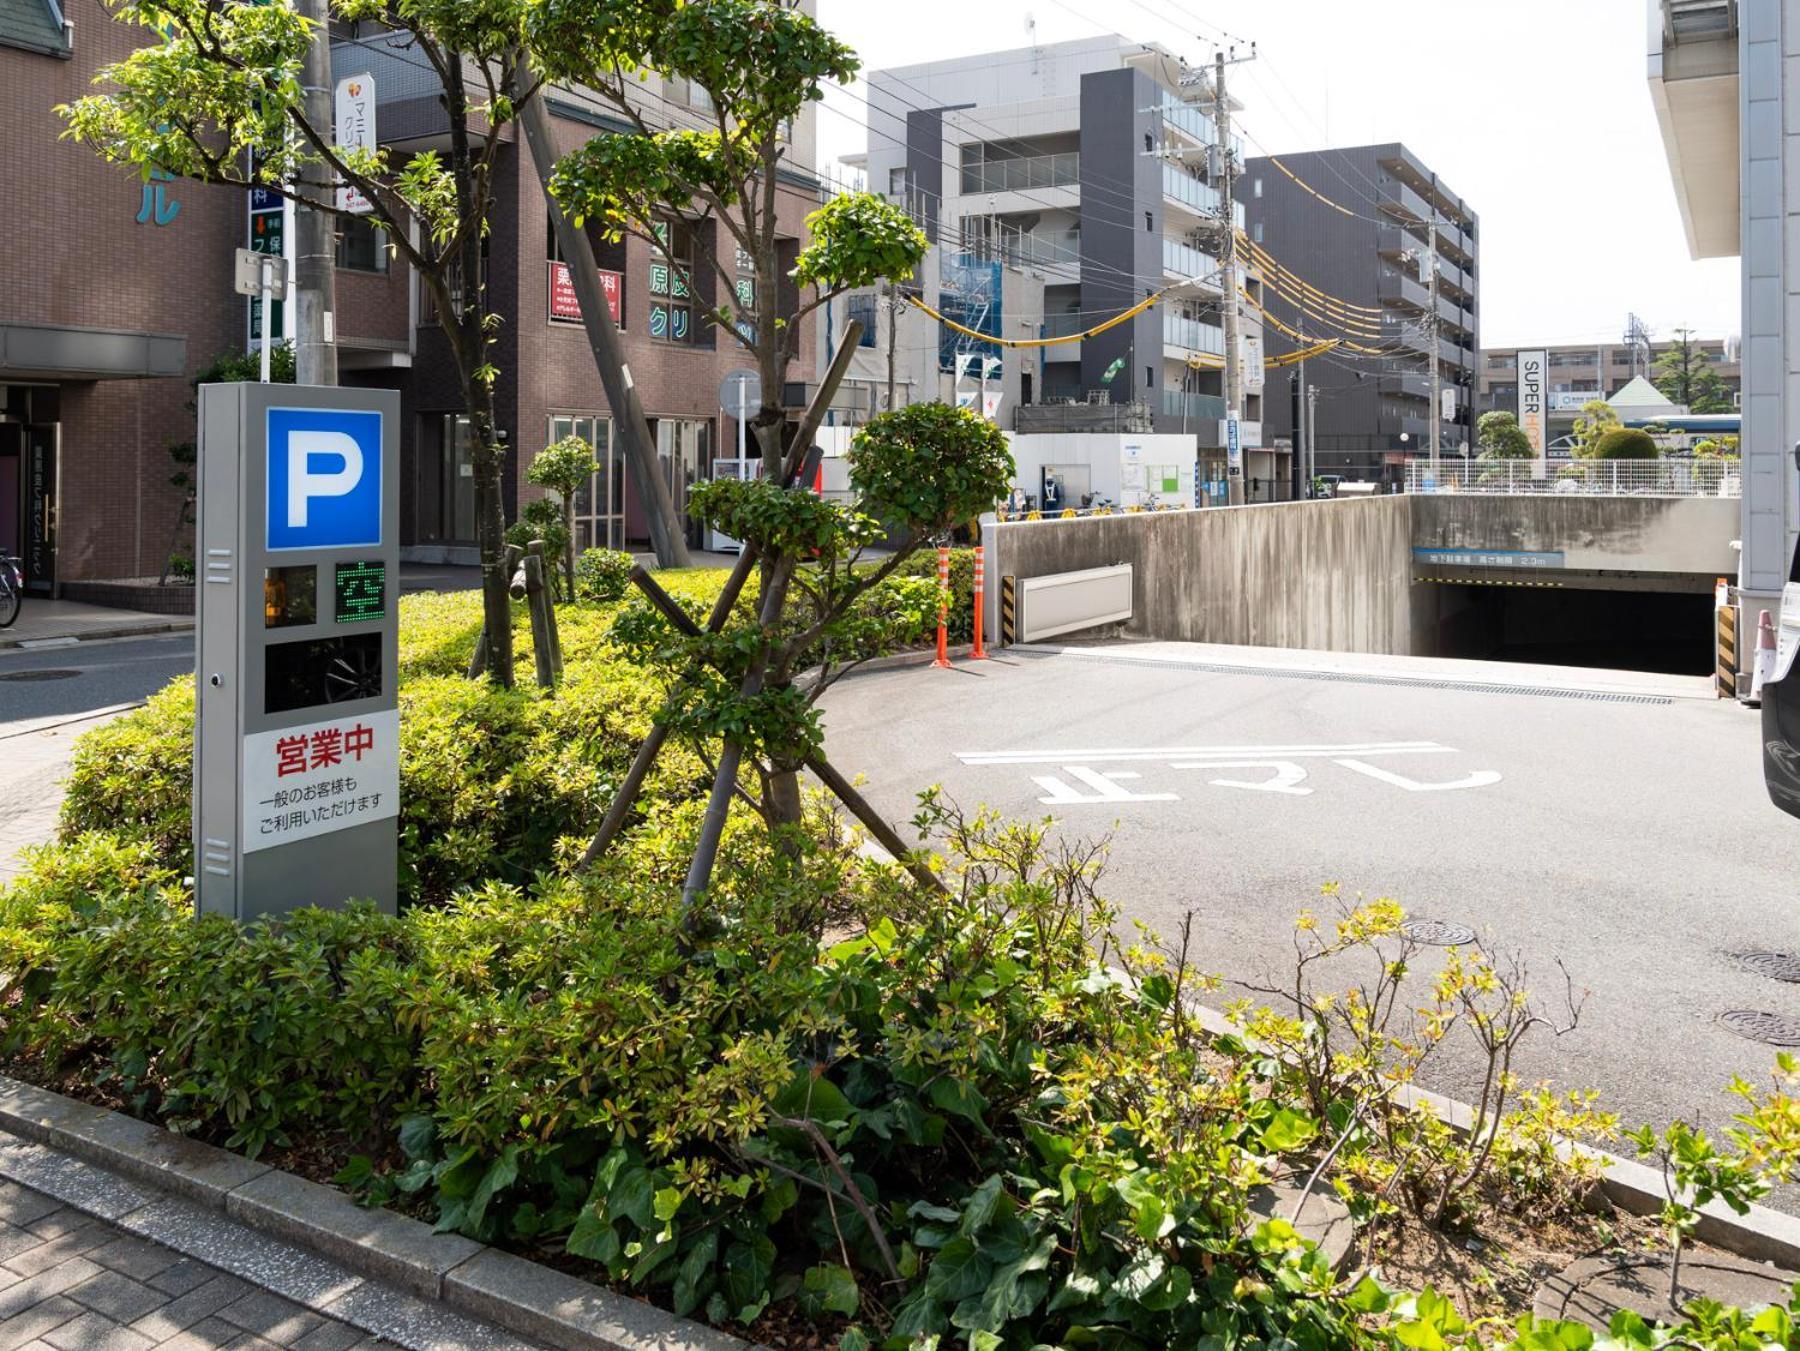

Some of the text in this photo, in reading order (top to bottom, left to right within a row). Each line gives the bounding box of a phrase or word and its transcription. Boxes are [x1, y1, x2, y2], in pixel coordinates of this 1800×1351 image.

[1524, 360, 1540, 414] SUPER
[287, 430, 364, 528] P
[336, 560, 385, 624] 空
[276, 723, 374, 778] 営業中
[259, 777, 357, 809] 一般のお客様も
[1030, 758, 1503, 805] 止マレ
[260, 793, 382, 834] ご利用いただけます
